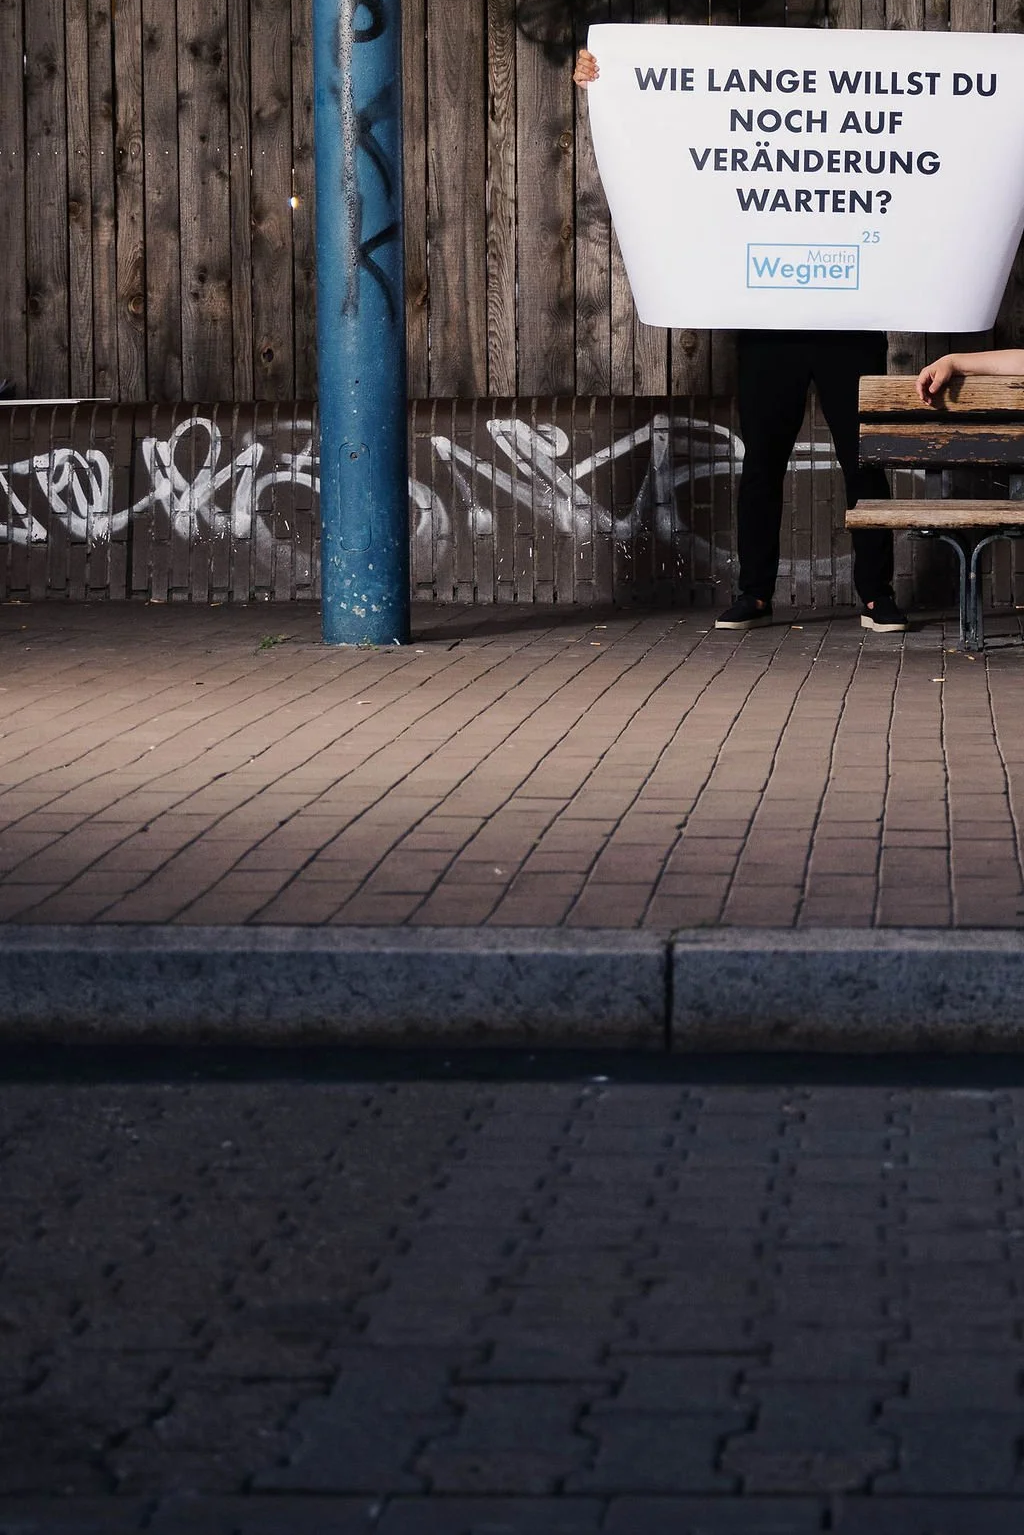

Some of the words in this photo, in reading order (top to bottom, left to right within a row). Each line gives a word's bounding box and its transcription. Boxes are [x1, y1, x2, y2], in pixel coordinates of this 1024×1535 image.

[634, 67, 695, 92] WIE
[707, 68, 817, 94] LANGE
[828, 70, 941, 96] WILLST
[952, 72, 997, 97] DU
[730, 108, 828, 134] NOCH
[839, 110, 903, 135] AUF
[688, 141, 941, 176] VERÄNDERUNG
[735, 188, 893, 215] WARTEN?
[862, 230, 880, 243] 25
[806, 249, 856, 263] Martin
[752, 257, 854, 284] Wegner
